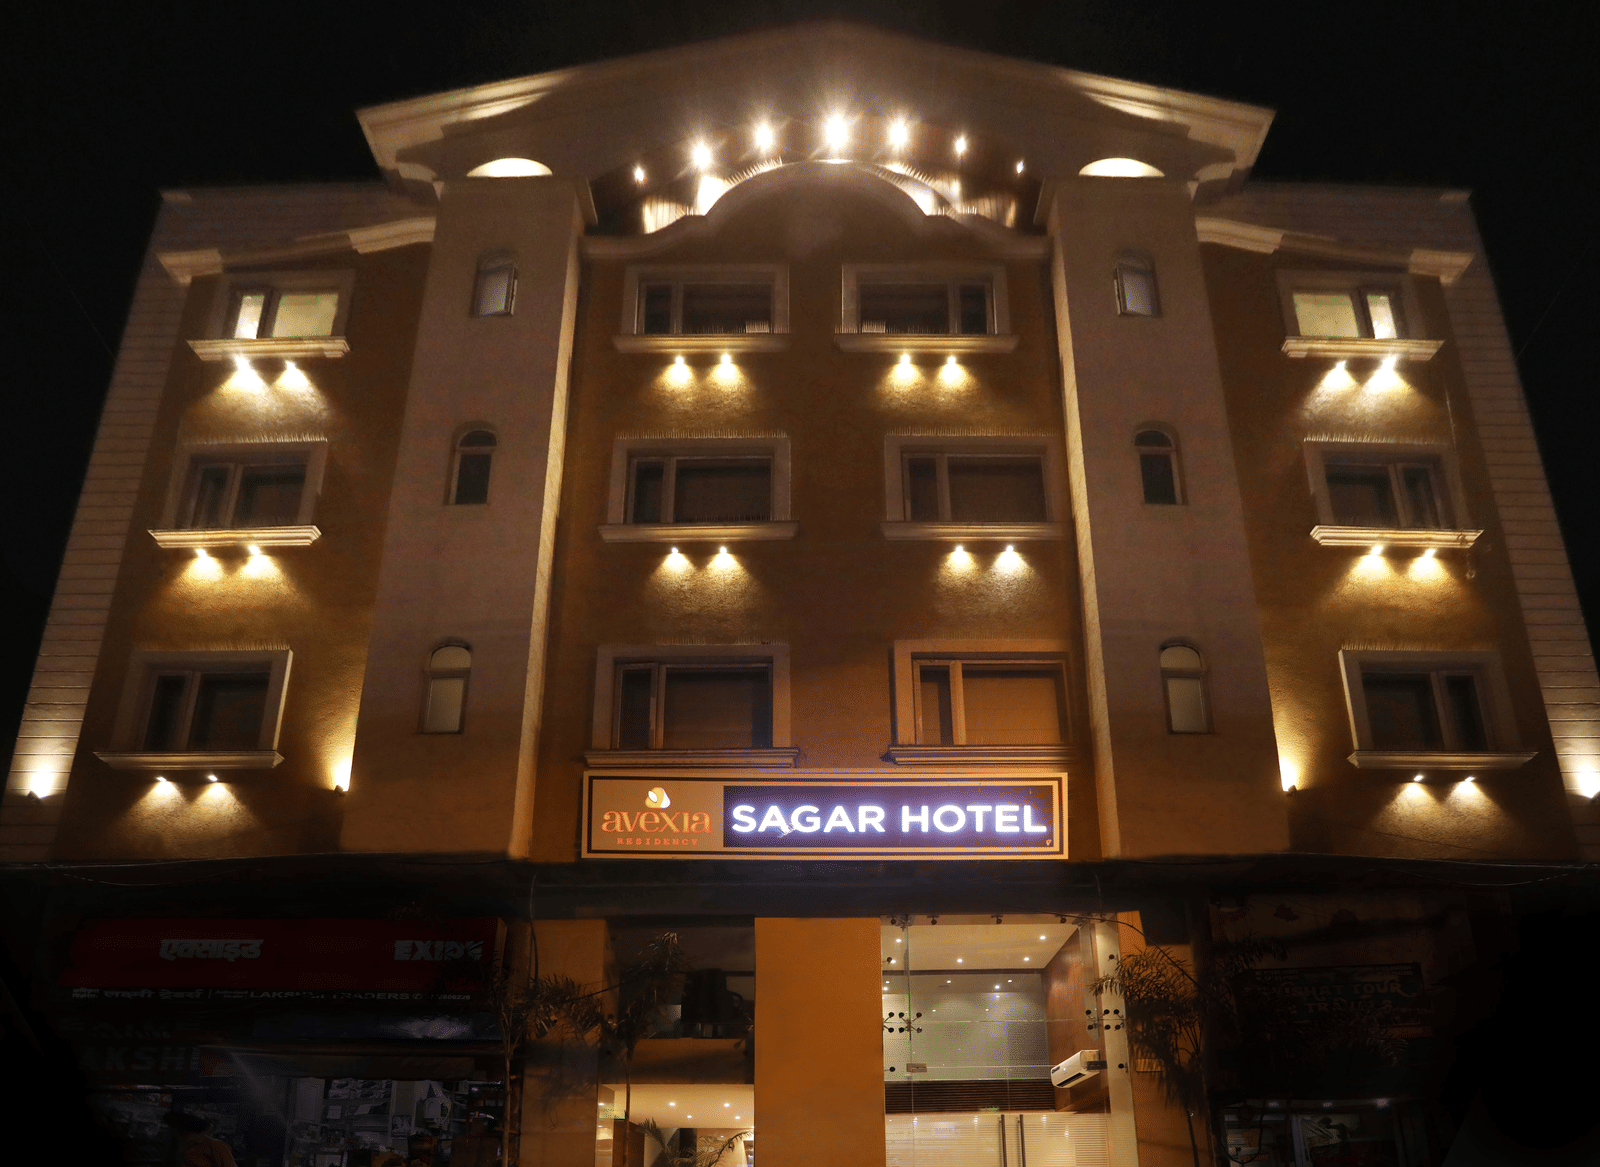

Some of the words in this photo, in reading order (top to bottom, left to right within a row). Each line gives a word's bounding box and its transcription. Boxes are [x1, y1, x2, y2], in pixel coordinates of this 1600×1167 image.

[601, 811, 713, 833] avexia
[732, 804, 886, 833] SAGAR
[901, 804, 1047, 833] HOTEL
[616, 837, 699, 846] RESIDENCY
[394, 939, 484, 961] EXIDE
[1350, 979, 1417, 998] TOUR
